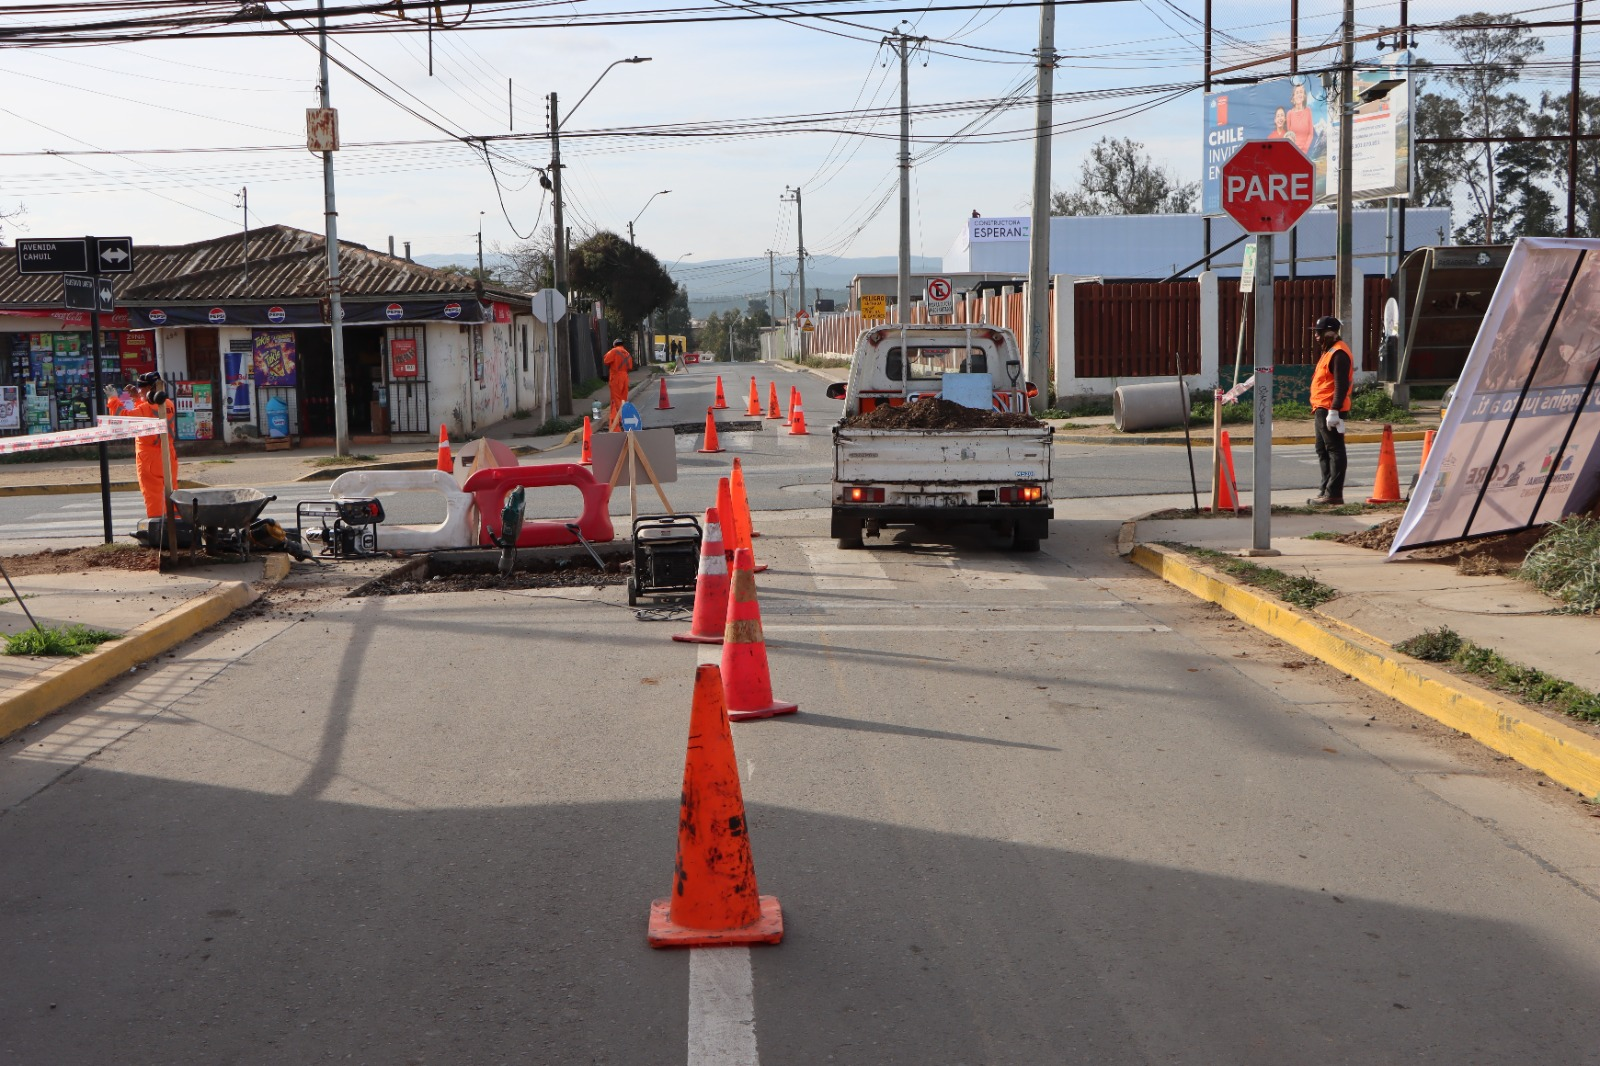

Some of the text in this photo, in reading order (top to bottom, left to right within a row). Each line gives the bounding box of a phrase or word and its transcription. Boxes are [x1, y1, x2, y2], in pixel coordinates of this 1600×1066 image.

[1209, 127, 1244, 145] CHILE
[1228, 174, 1309, 202] PARE
[974, 226, 1029, 238] ESPERANZ
